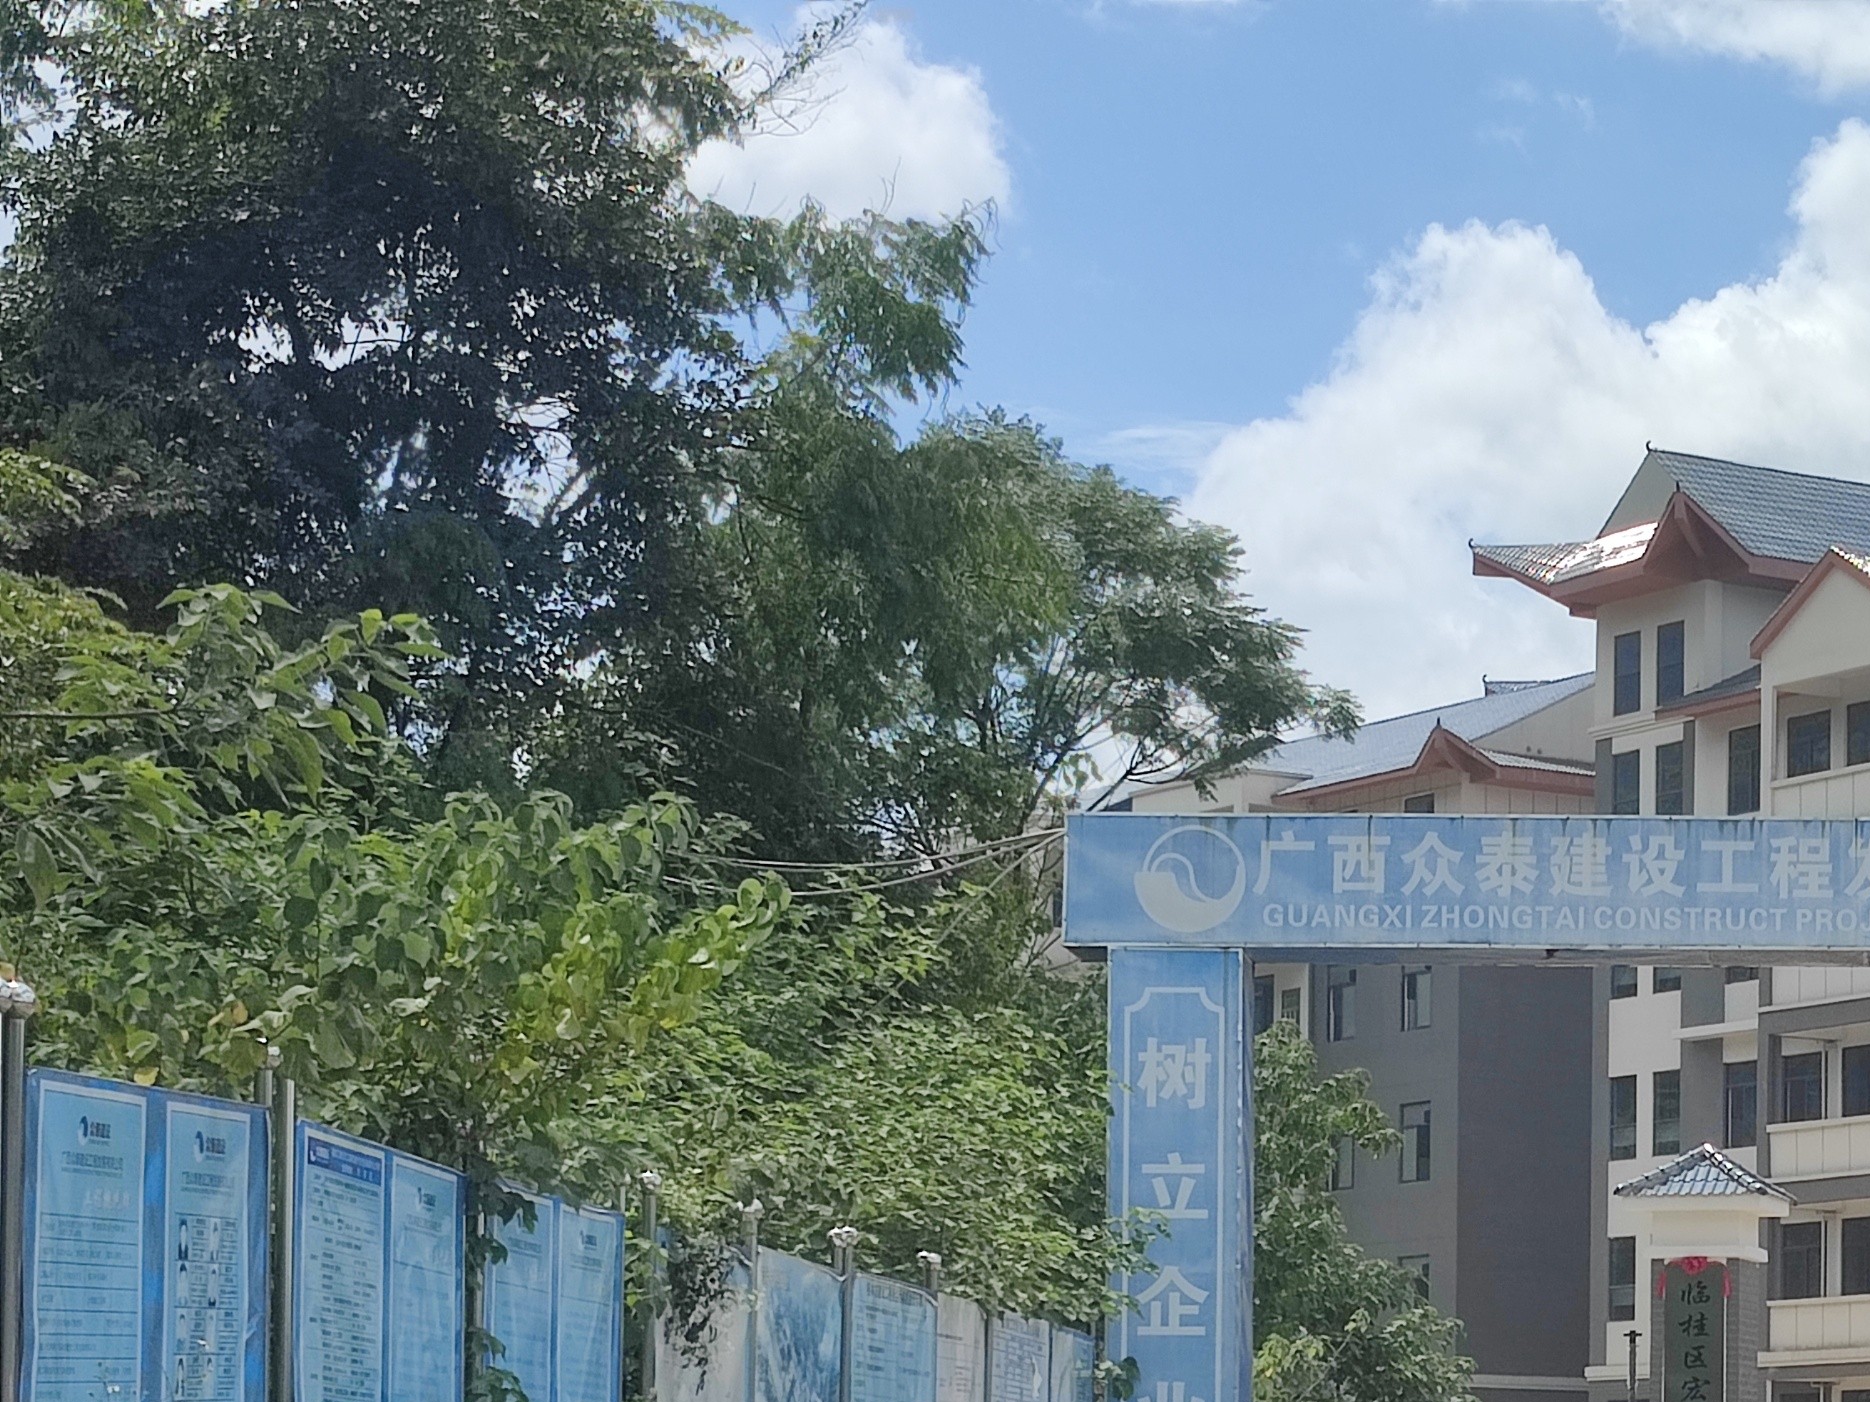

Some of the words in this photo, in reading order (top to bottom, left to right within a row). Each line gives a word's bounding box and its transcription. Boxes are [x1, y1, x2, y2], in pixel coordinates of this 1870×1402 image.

[1263, 904, 1412, 929] GUANGXI
[1421, 905, 1585, 930] ZHONGTAI
[1595, 906, 1787, 933] CONSTRUCT
